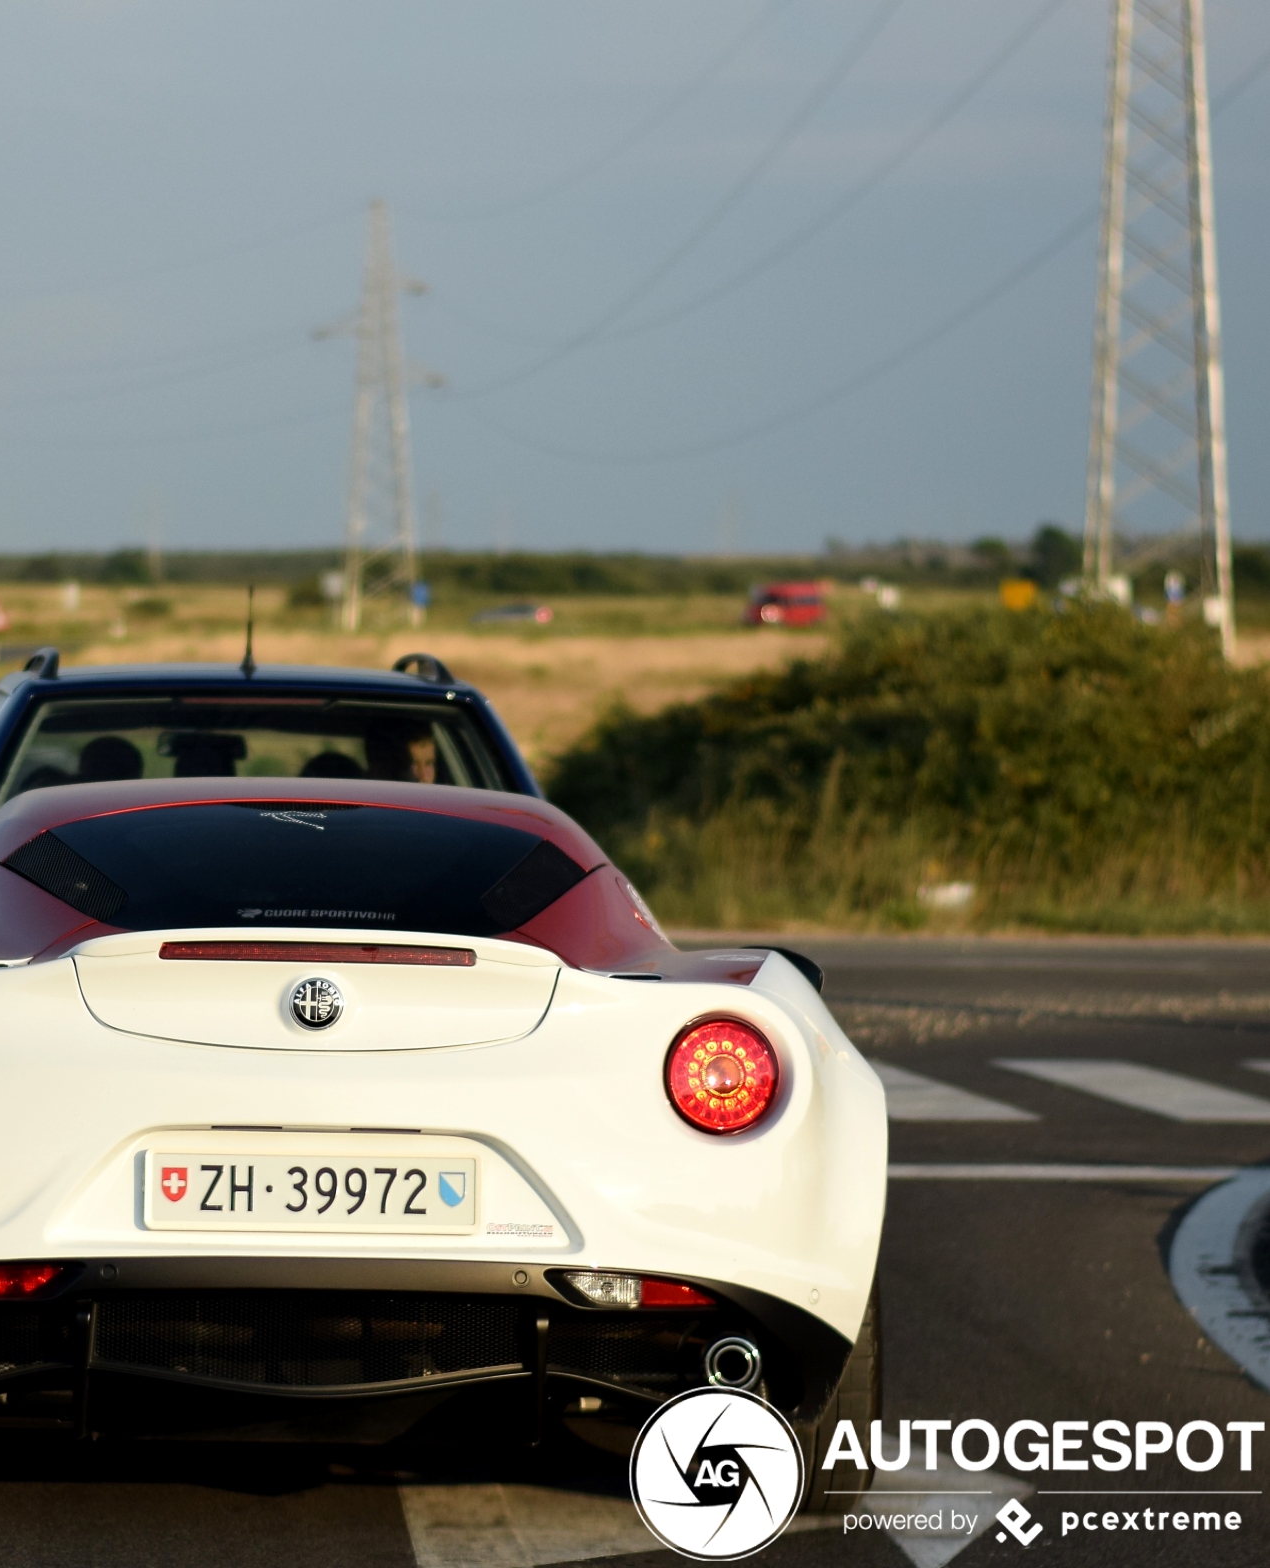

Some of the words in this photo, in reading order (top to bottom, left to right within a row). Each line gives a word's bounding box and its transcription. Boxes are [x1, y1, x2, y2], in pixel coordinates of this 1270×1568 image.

[264, 909, 309, 918] CUORE
[310, 909, 377, 920] SPORTIVO
[293, 982, 312, 1005] ALFA
